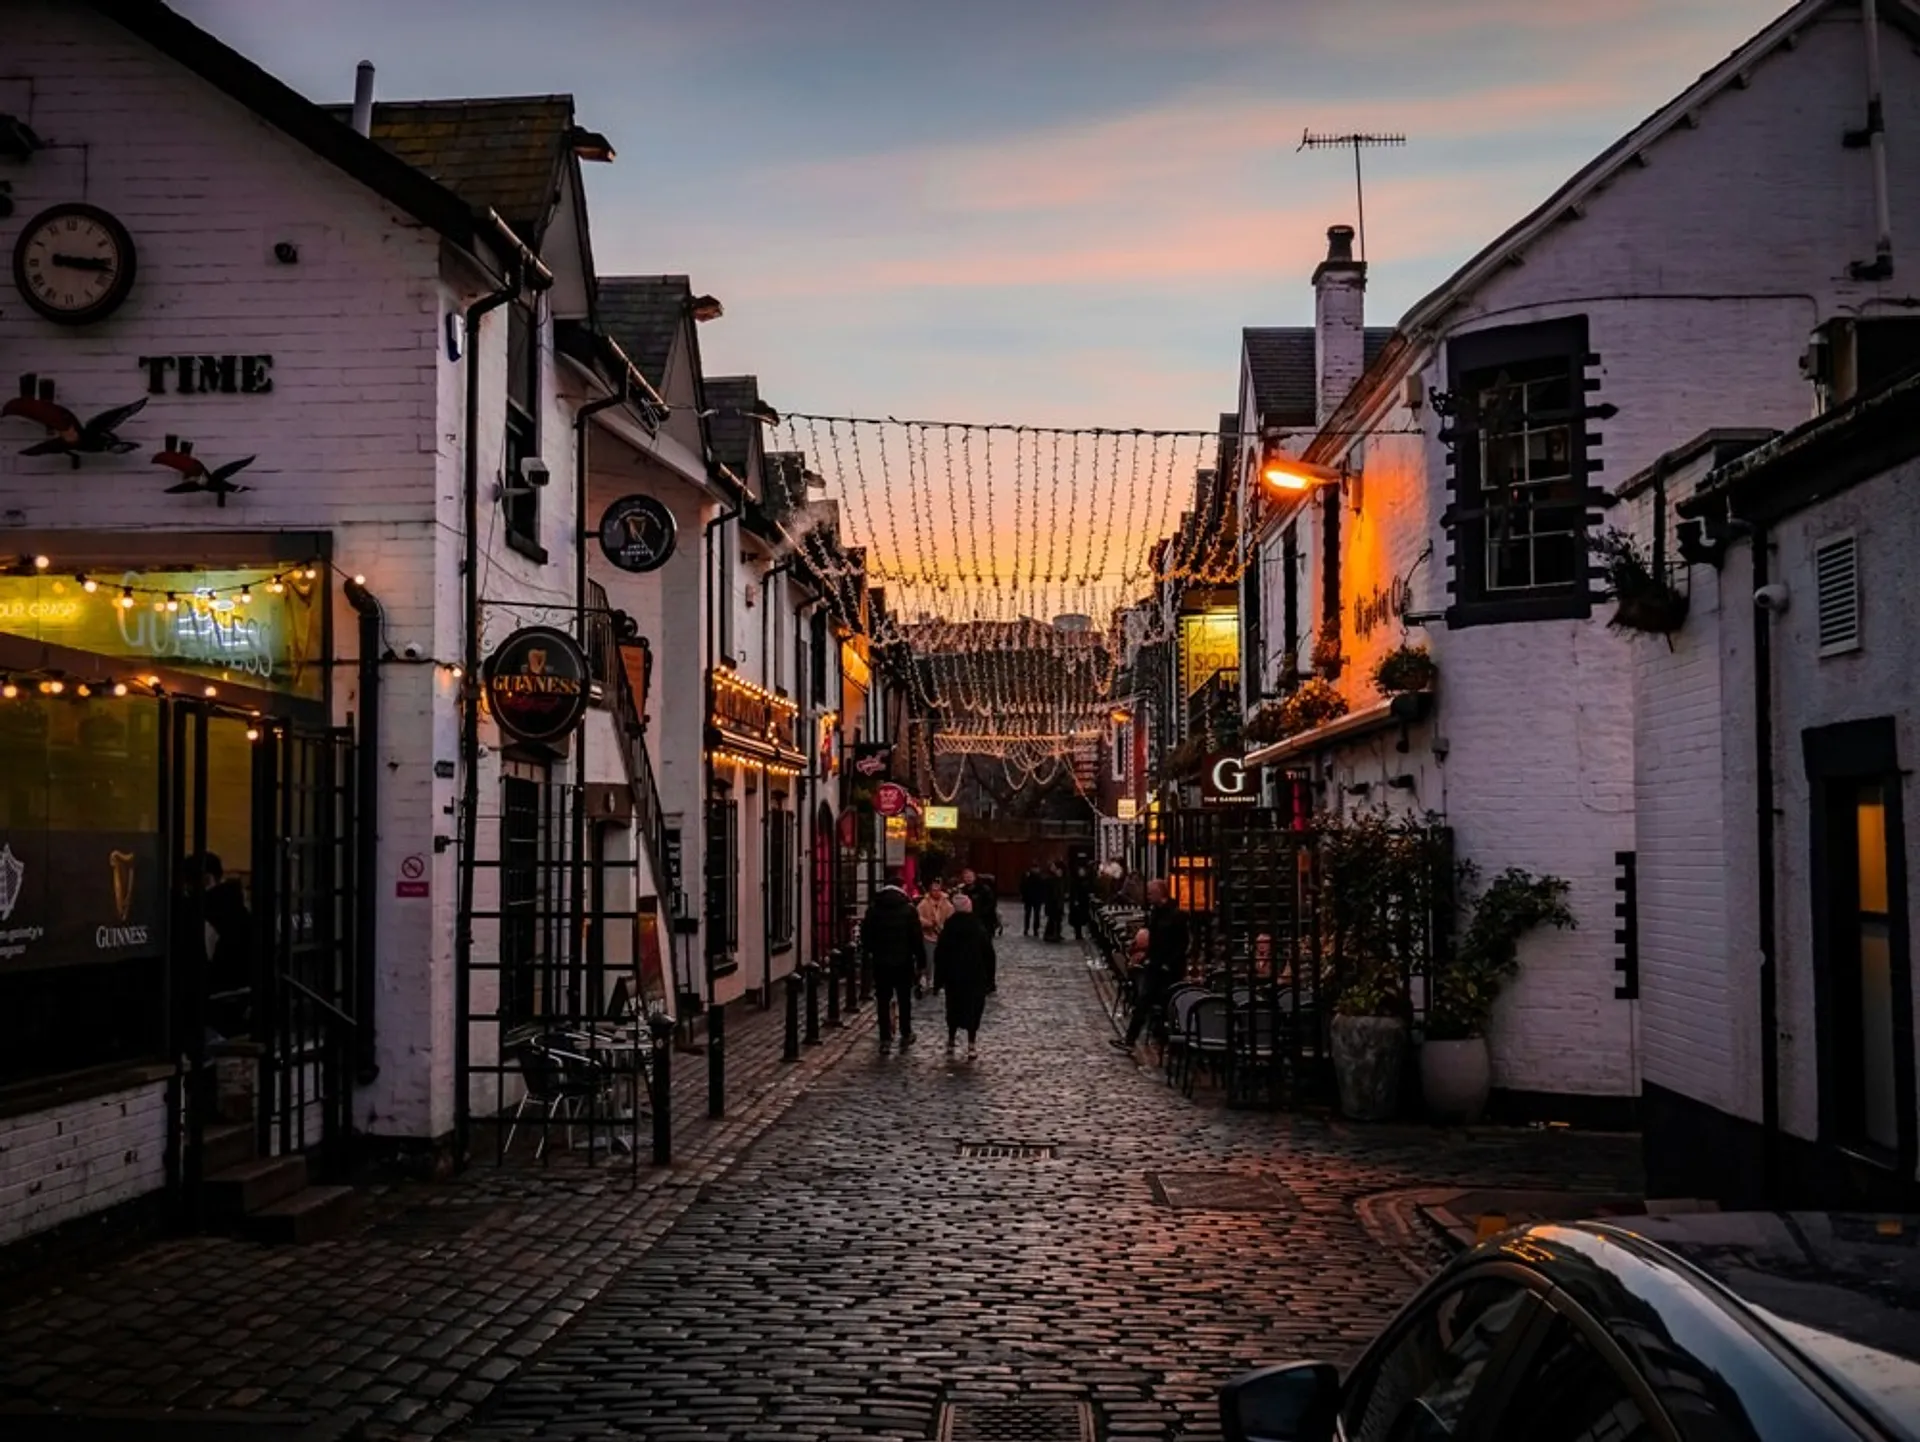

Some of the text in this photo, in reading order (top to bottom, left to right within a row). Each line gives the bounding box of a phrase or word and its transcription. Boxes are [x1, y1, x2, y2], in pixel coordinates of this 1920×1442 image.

[139, 355, 273, 395] TIME
[491, 674, 582, 696] GUINNESS
[1212, 757, 1246, 793] G
[96, 924, 149, 950] GUINNESS
